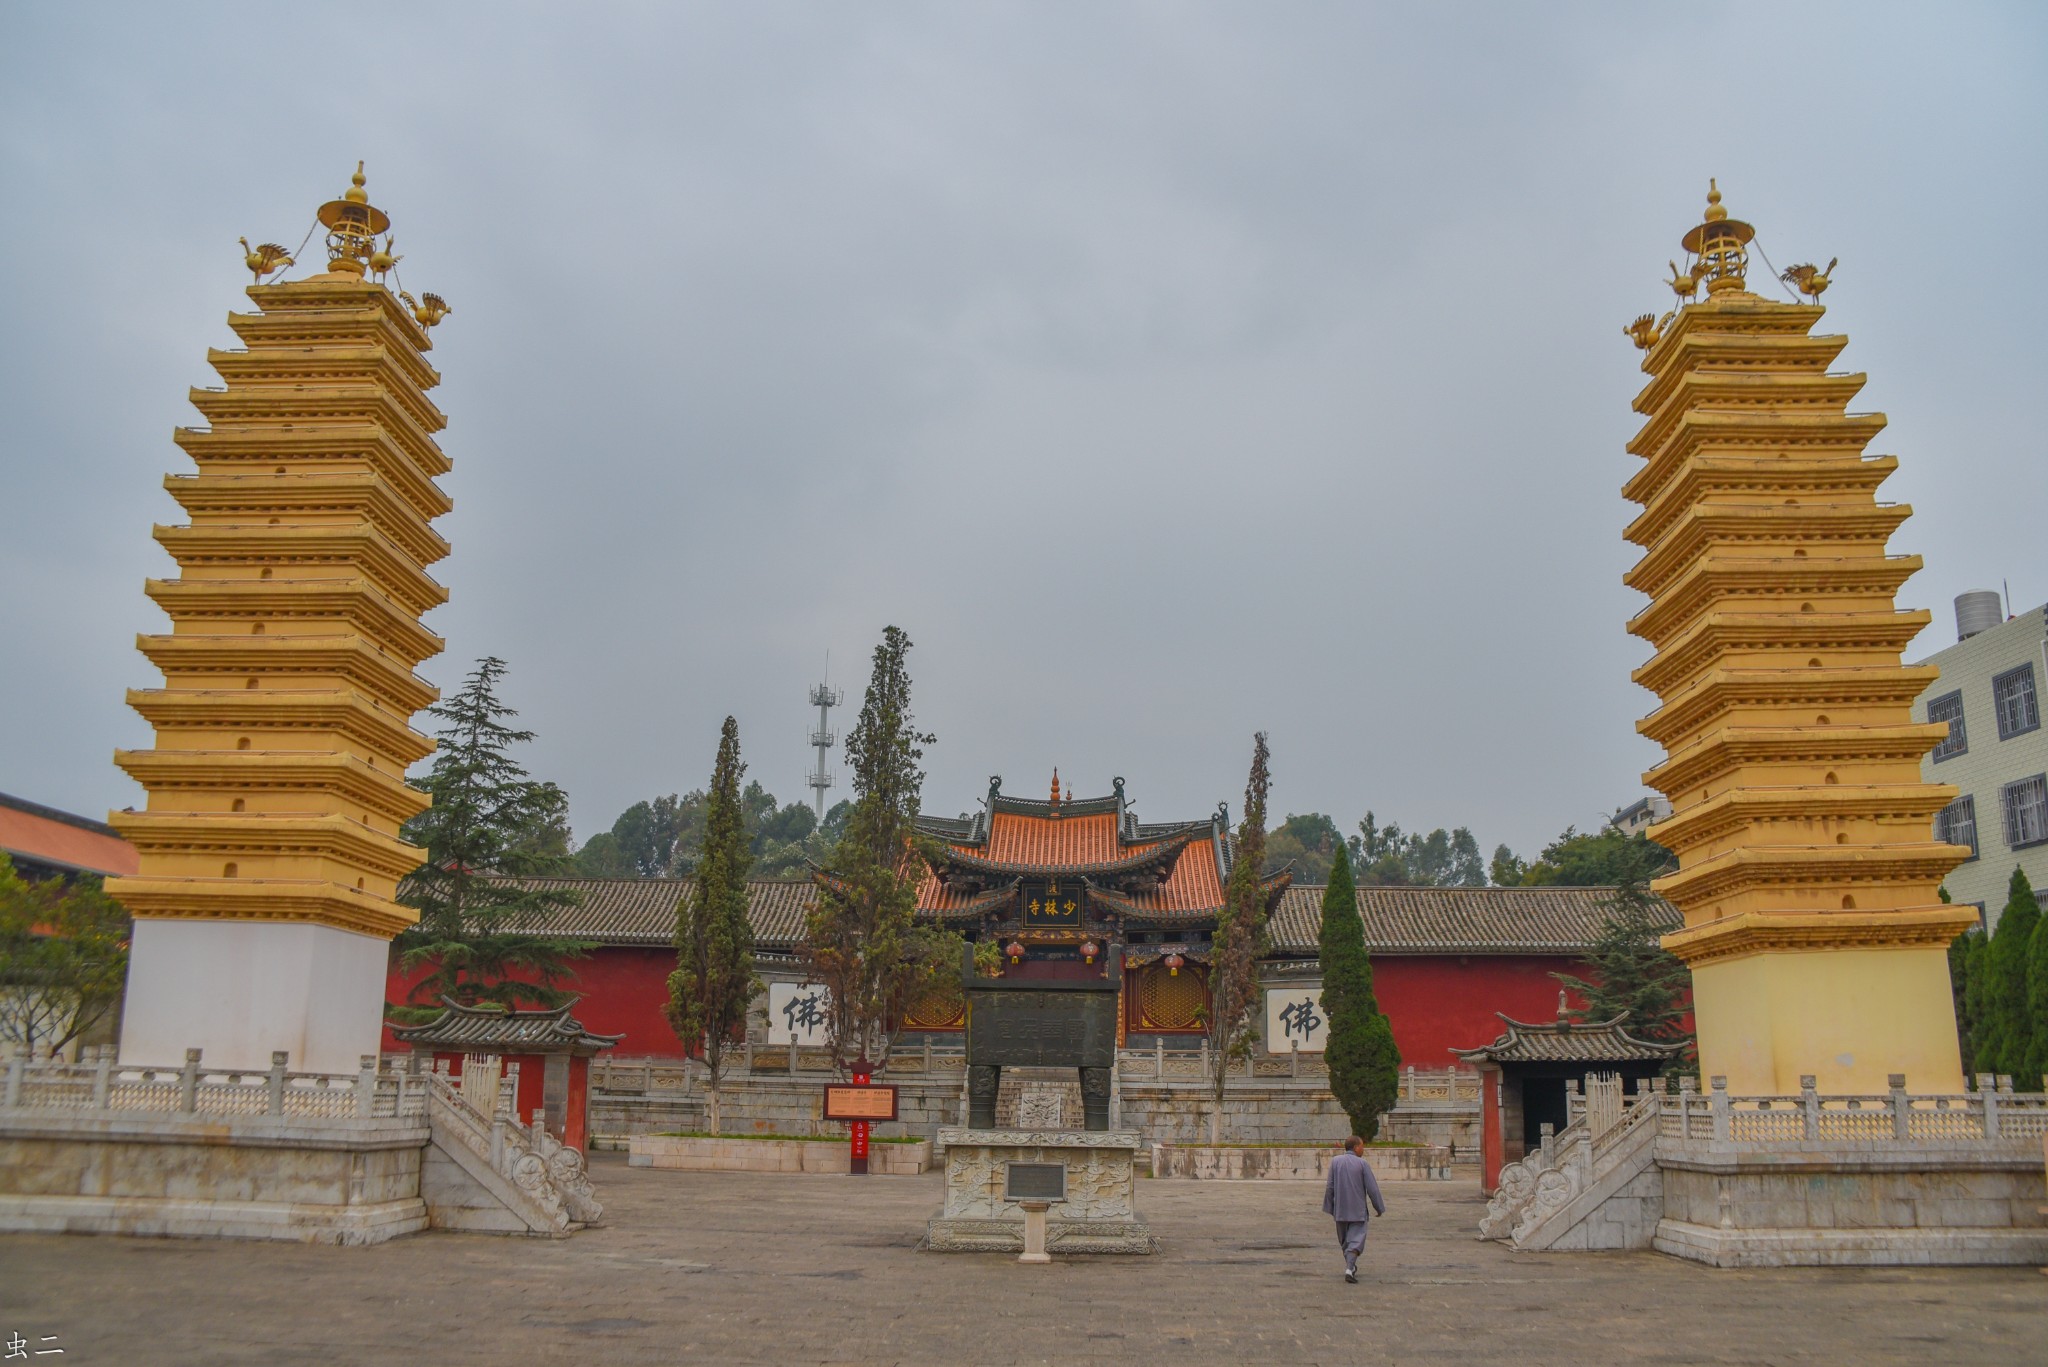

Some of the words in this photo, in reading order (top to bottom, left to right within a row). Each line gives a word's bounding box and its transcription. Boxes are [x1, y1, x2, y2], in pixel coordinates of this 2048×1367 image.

[1028, 898, 1077, 917] 少林寺
[782, 991, 825, 1038] 佛
[1279, 997, 1321, 1043] 佛
